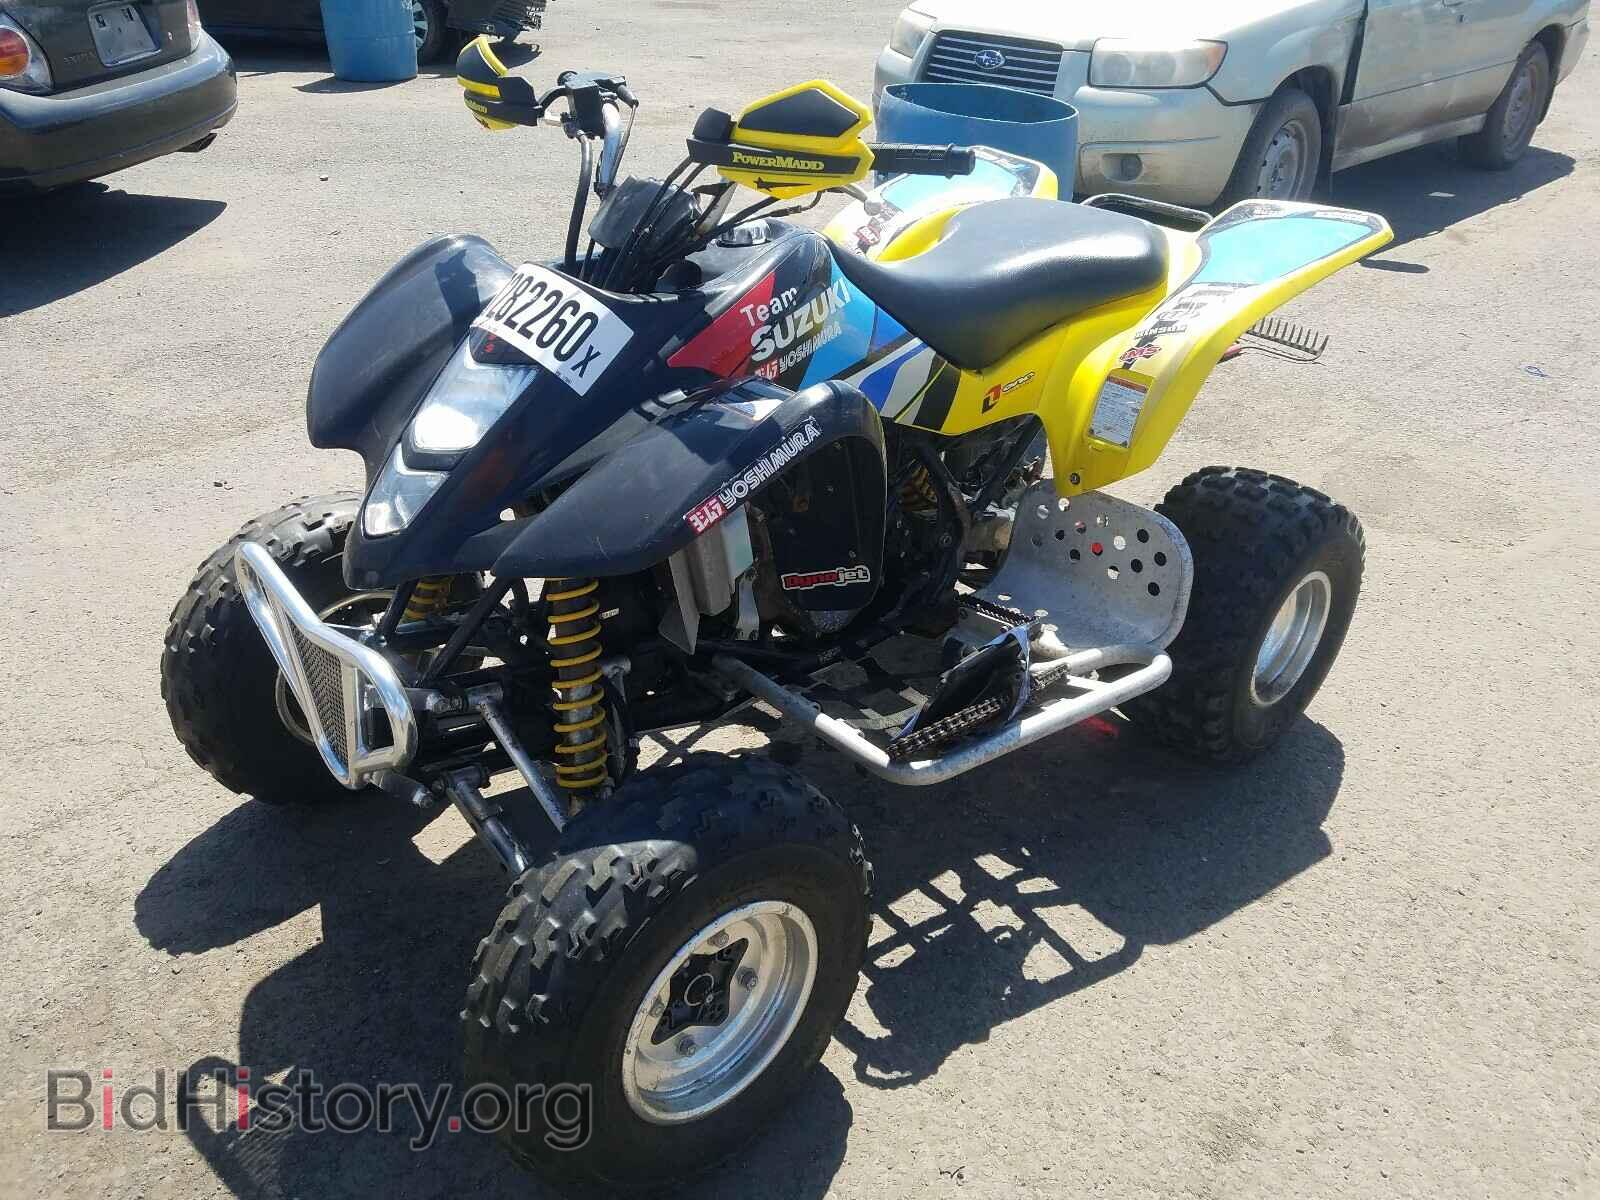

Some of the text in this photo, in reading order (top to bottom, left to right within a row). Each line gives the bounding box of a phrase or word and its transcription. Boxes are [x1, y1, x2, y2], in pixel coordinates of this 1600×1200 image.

[740, 287, 798, 327] Team
[751, 277, 851, 361] SUZUKI
[719, 423, 822, 509] YOSHIMURA
